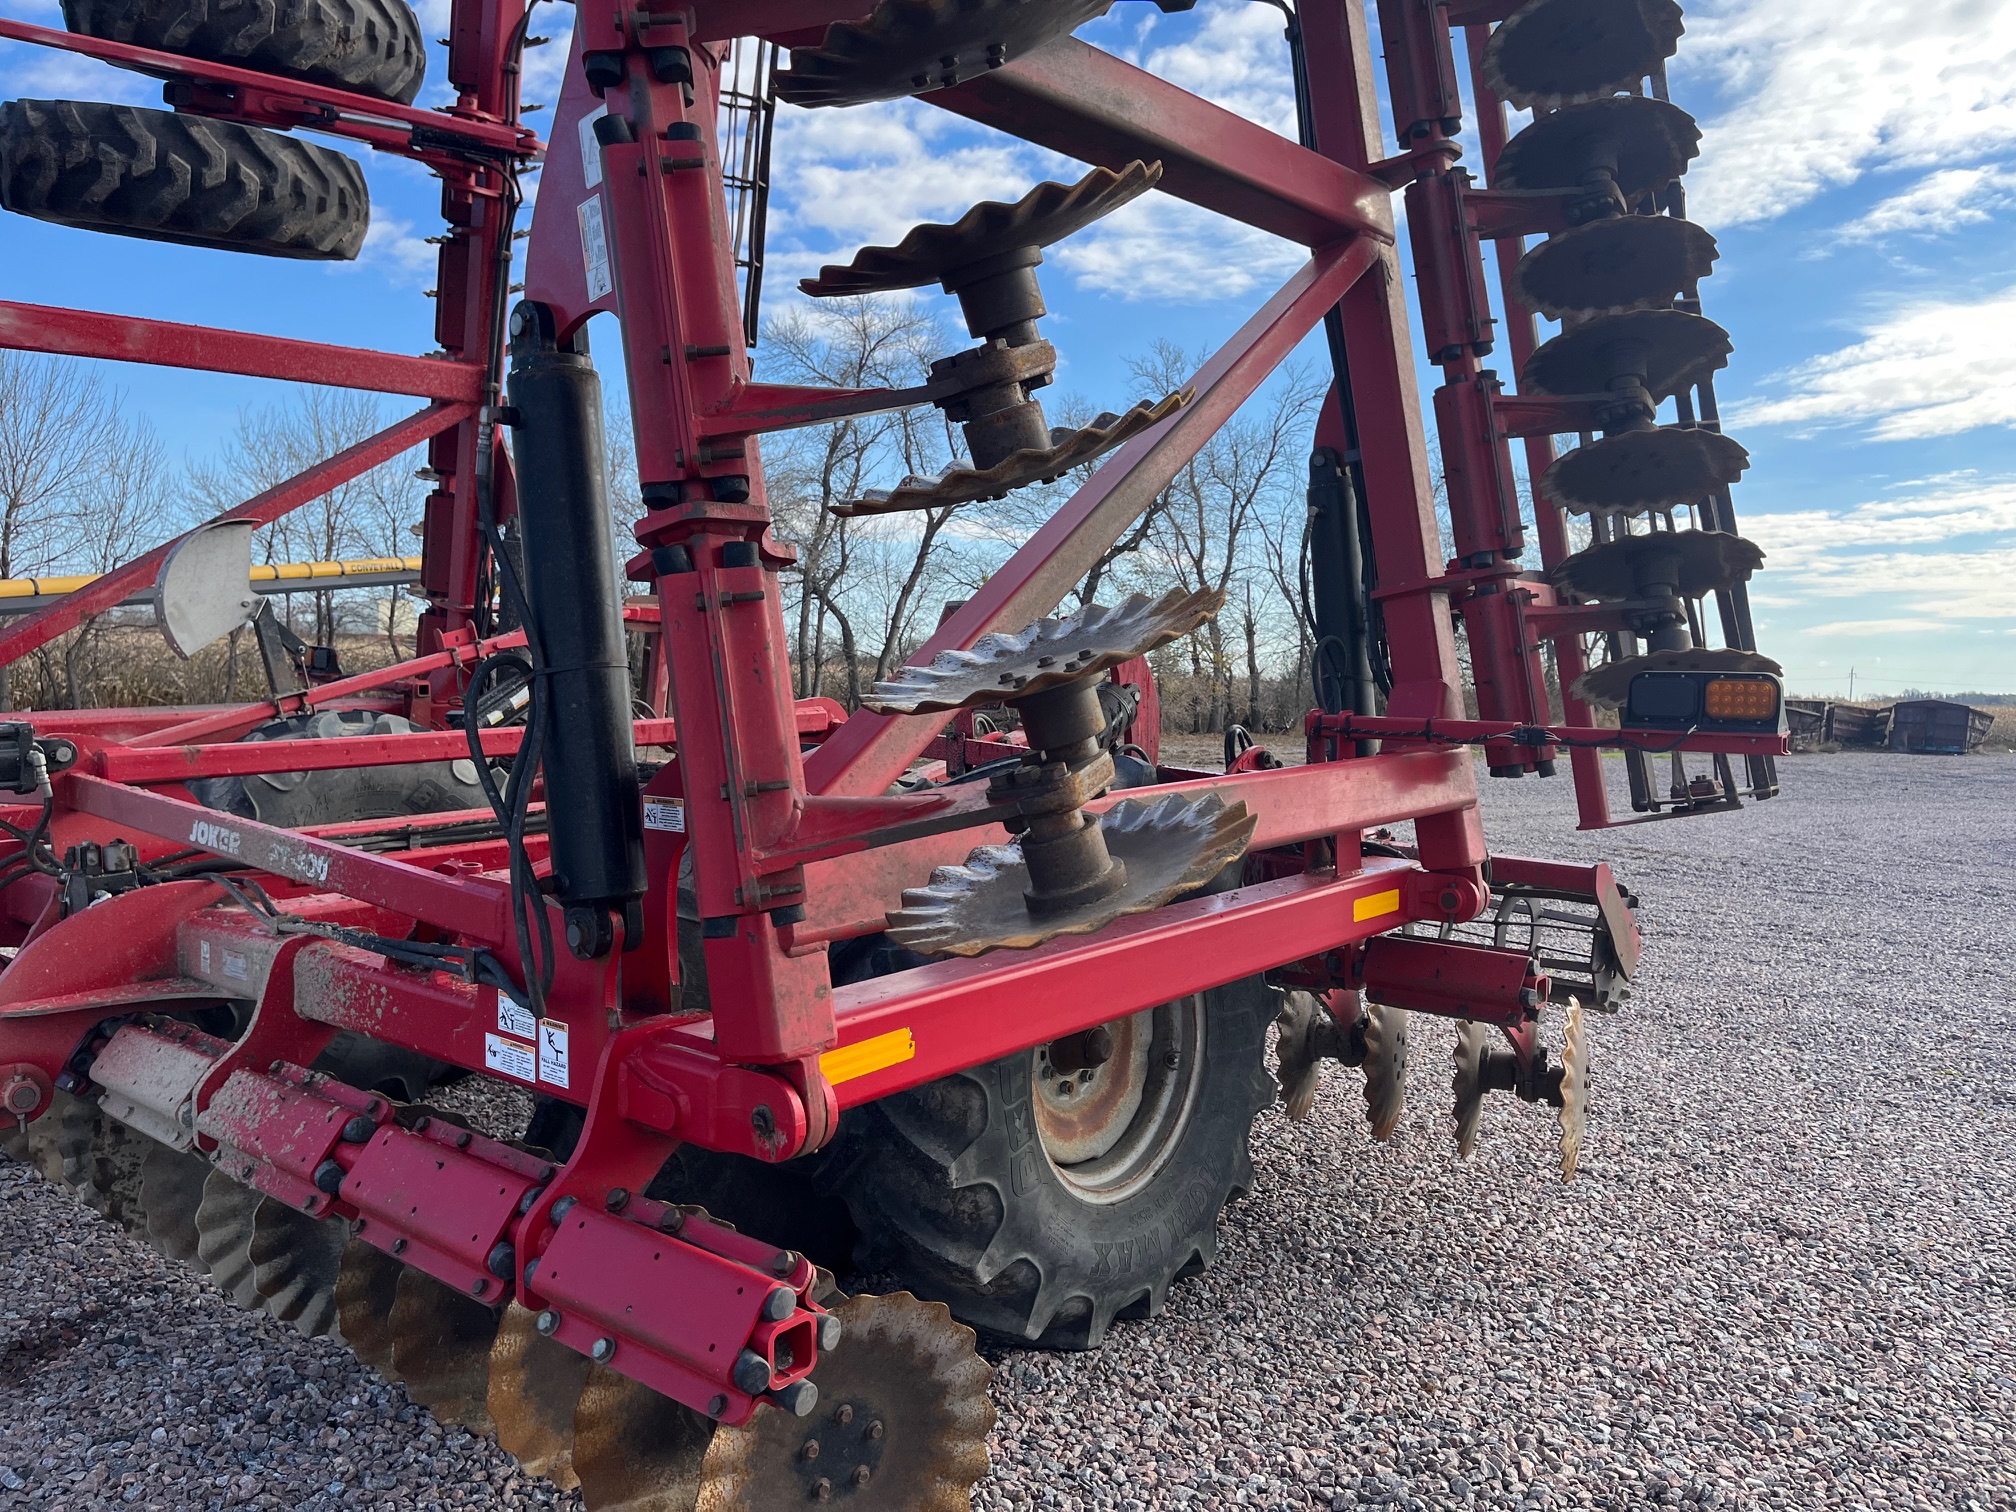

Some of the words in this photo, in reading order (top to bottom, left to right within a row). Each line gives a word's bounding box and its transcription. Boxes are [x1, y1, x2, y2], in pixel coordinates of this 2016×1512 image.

[351, 562, 400, 572] CONVEY-ALL
[189, 820, 241, 854] JOKER
[551, 1060, 567, 1069] HAZARD
[1163, 1153, 1221, 1250] AGRI
[1089, 1227, 1163, 1277] MAX
